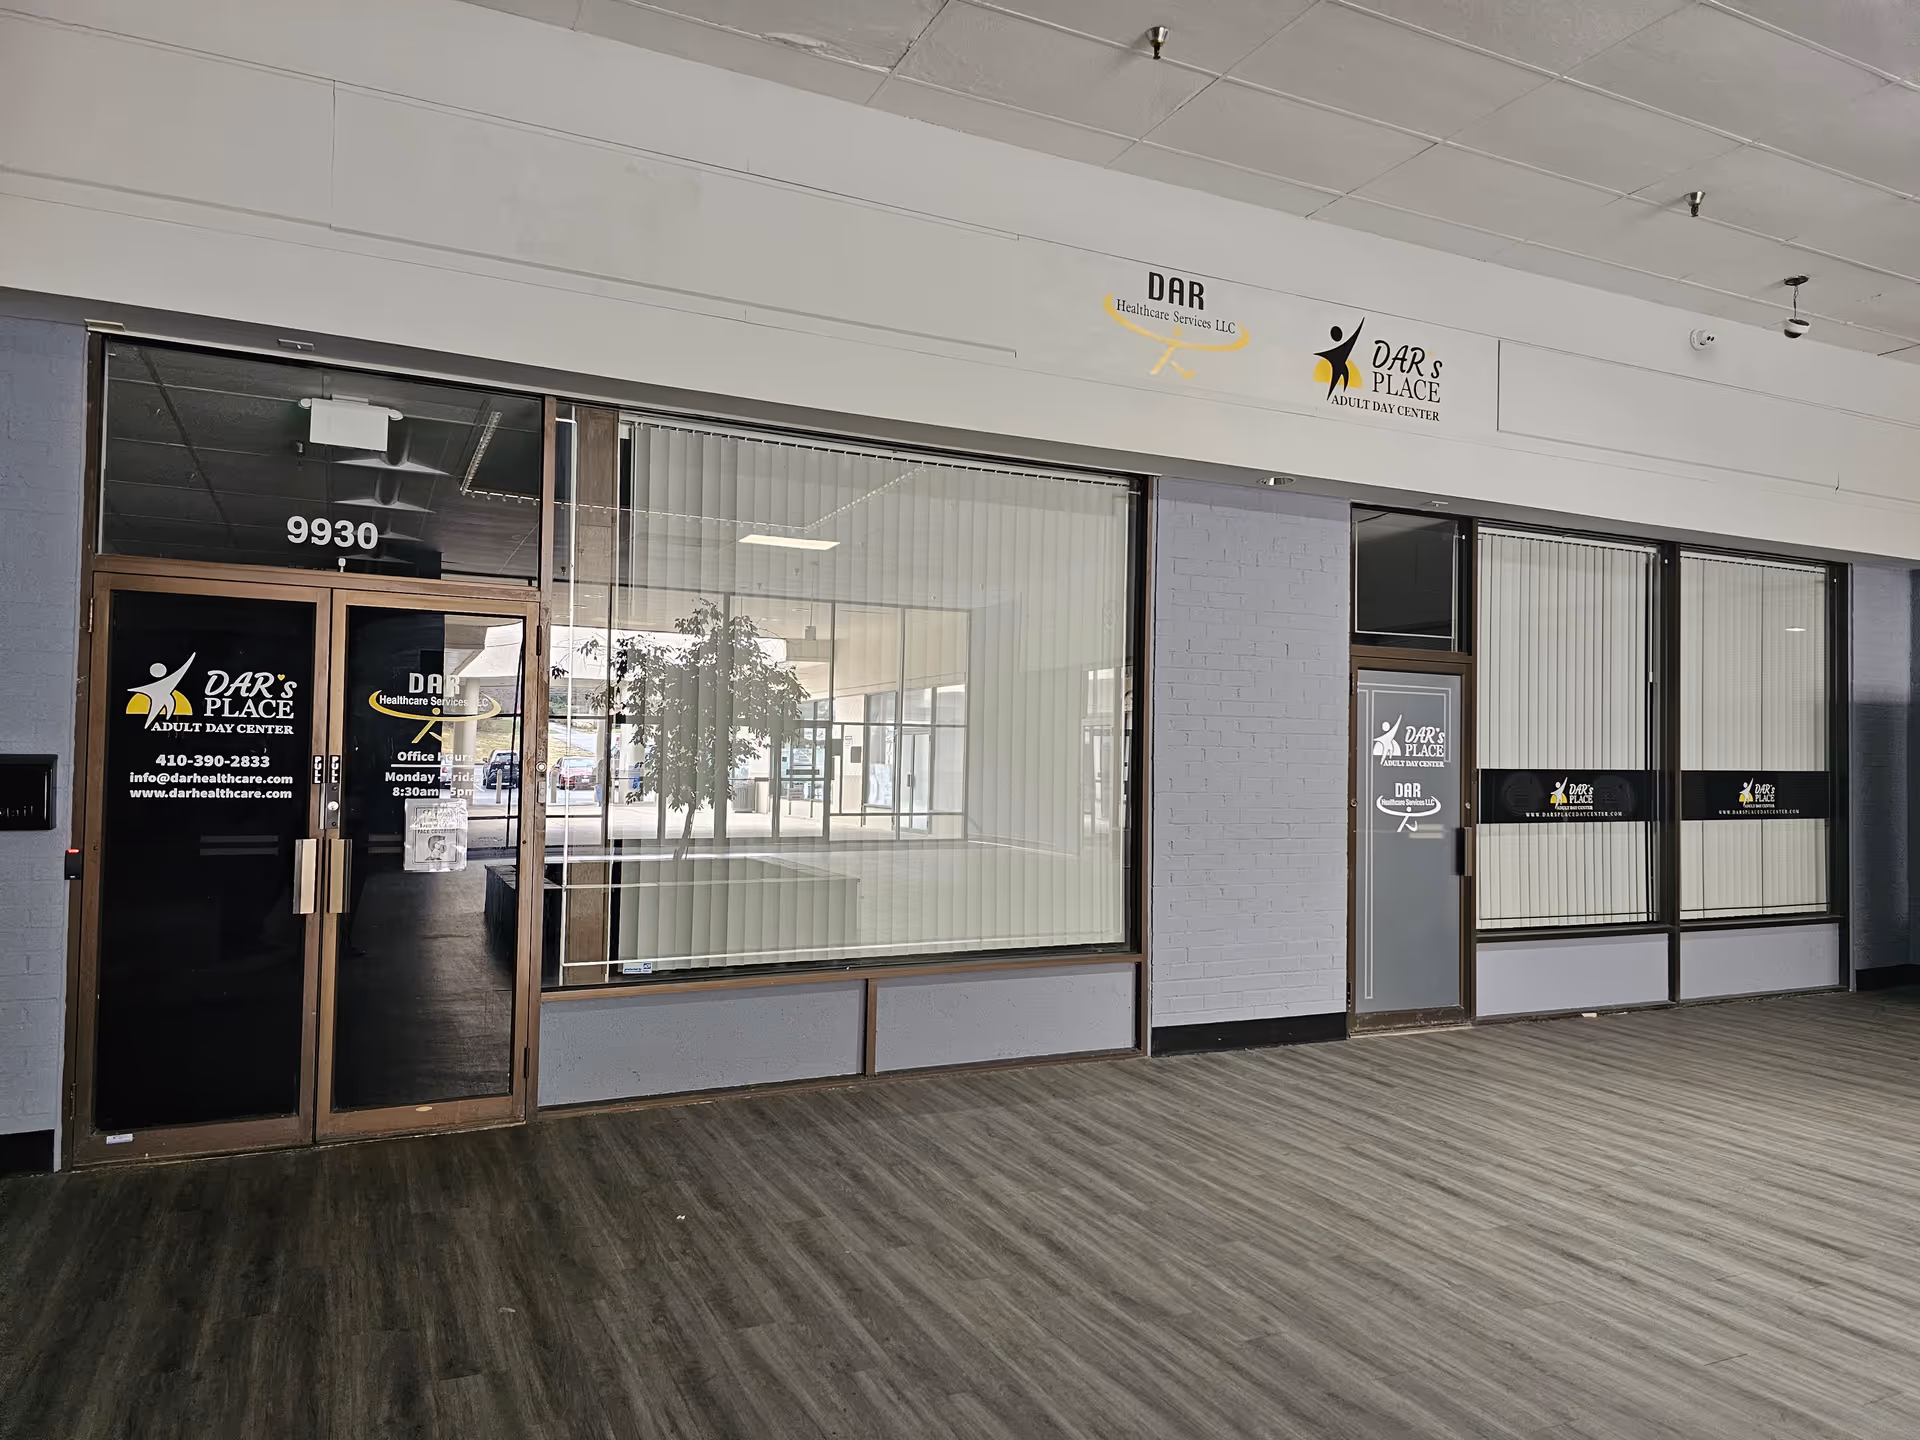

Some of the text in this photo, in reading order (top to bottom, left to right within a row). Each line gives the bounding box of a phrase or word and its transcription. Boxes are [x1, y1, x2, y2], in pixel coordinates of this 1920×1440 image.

[1148, 271, 1205, 311] DAR
[1116, 298, 1236, 335] Healthcare Services LLC
[1372, 370, 1441, 404] PLACE
[1331, 394, 1440, 422] ADULT DAY CENTER
[286, 515, 379, 550] 9930
[204, 669, 298, 699] DAR's
[408, 672, 461, 696] DAR
[203, 697, 295, 719] PLACE
[379, 694, 429, 706] Healthcare
[430, 696, 469, 708] Services
[150, 721, 294, 735] ADULT DAY CENTER
[397, 750, 435, 762] Office
[1404, 743, 1445, 757] PLACE
[155, 753, 271, 768] 410-390-2833
[1419, 760, 1445, 768] CENTER
[313, 756, 323, 784] PULL
[330, 756, 340, 784] PULL
[129, 771, 294, 785] info@darhealthcare.com
[385, 771, 436, 785] Monday
[129, 787, 293, 799] www.darhealthcare.com
[392, 786, 475, 799] 8:30am 5pm
[1394, 782, 1421, 798] DAR
[1425, 798, 1435, 806] LLC
[1568, 795, 1594, 804] PLACE
[1754, 794, 1776, 803] PLACE
